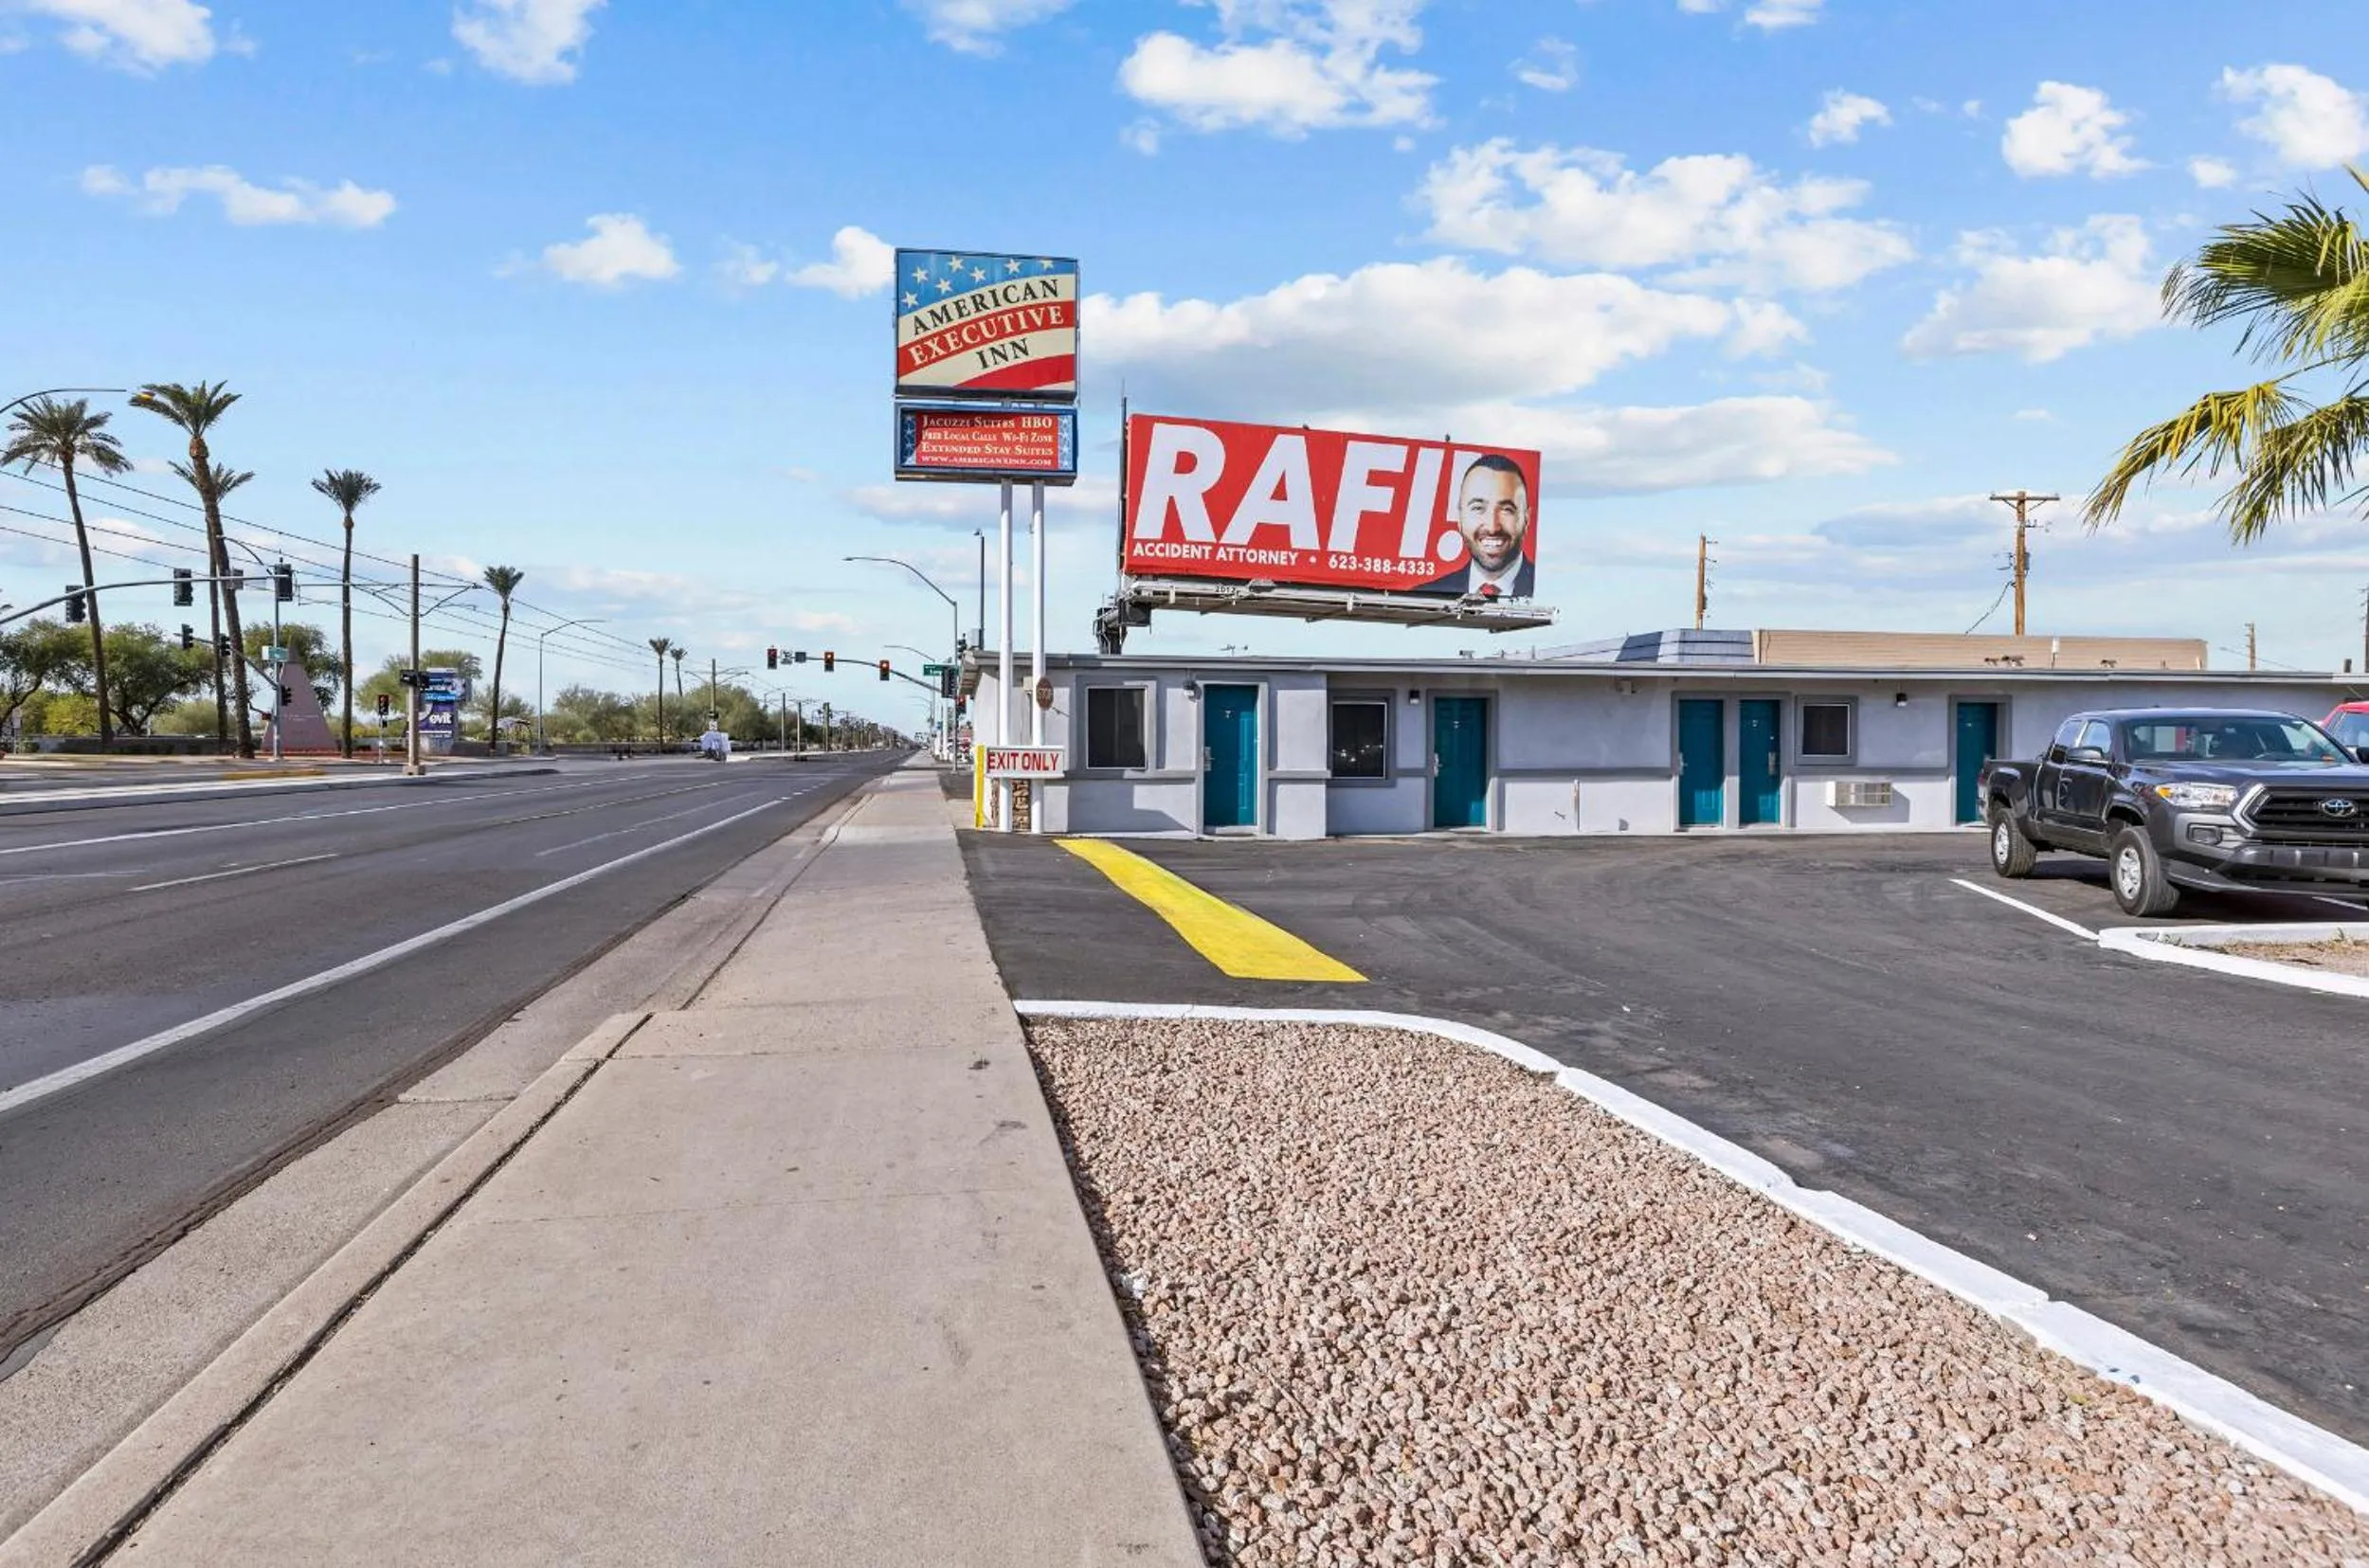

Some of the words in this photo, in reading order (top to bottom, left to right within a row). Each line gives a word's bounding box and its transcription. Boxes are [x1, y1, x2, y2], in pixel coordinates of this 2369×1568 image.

[914, 279, 1058, 335] AMERICAN
[909, 305, 1064, 366] EXECUTIVE
[976, 338, 1031, 369] INN
[974, 416, 1015, 428] SUITES
[1022, 416, 1053, 428] HBO
[921, 442, 982, 453] EXTENDED
[985, 443, 1011, 455] STAY
[1015, 444, 1054, 456] SUITES
[1132, 542, 1213, 560] ACCIDENT
[1216, 547, 1298, 566] ATTORNEY
[1329, 555, 1436, 576] 623-388-4333
[429, 712, 452, 724] evit
[987, 750, 1019, 769] EXIT
[1022, 752, 1059, 771] ONLY
